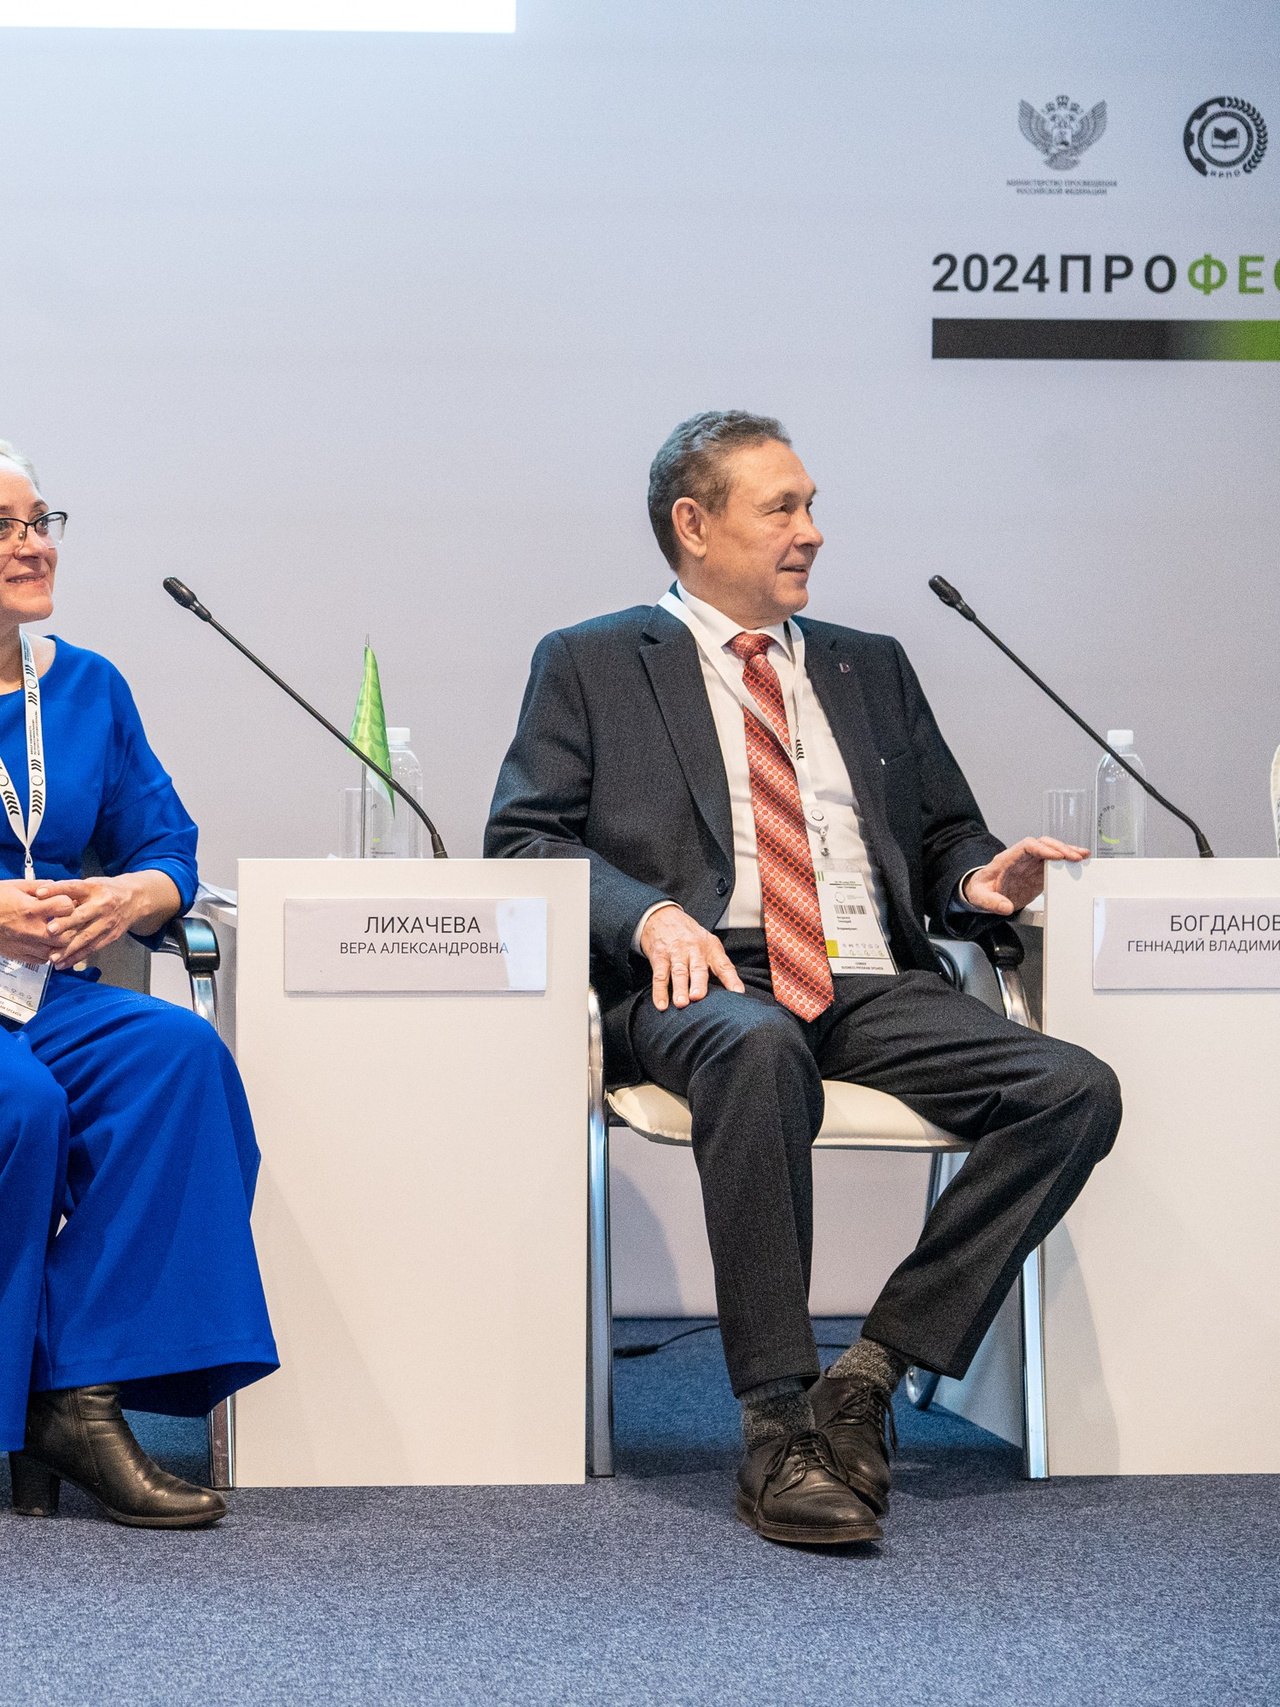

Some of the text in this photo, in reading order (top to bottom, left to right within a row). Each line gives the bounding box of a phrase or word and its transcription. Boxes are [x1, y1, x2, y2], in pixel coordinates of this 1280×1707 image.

[364, 916, 481, 934] ЛИХАЧЕВА
[1170, 914, 1280, 935] БОГДАНОВ
[340, 942, 509, 956] ВЕРА АЛЕКСАНДРОВНА
[1127, 938, 1280, 954] ГЕННАДИЙ ВЛАДИМИ
